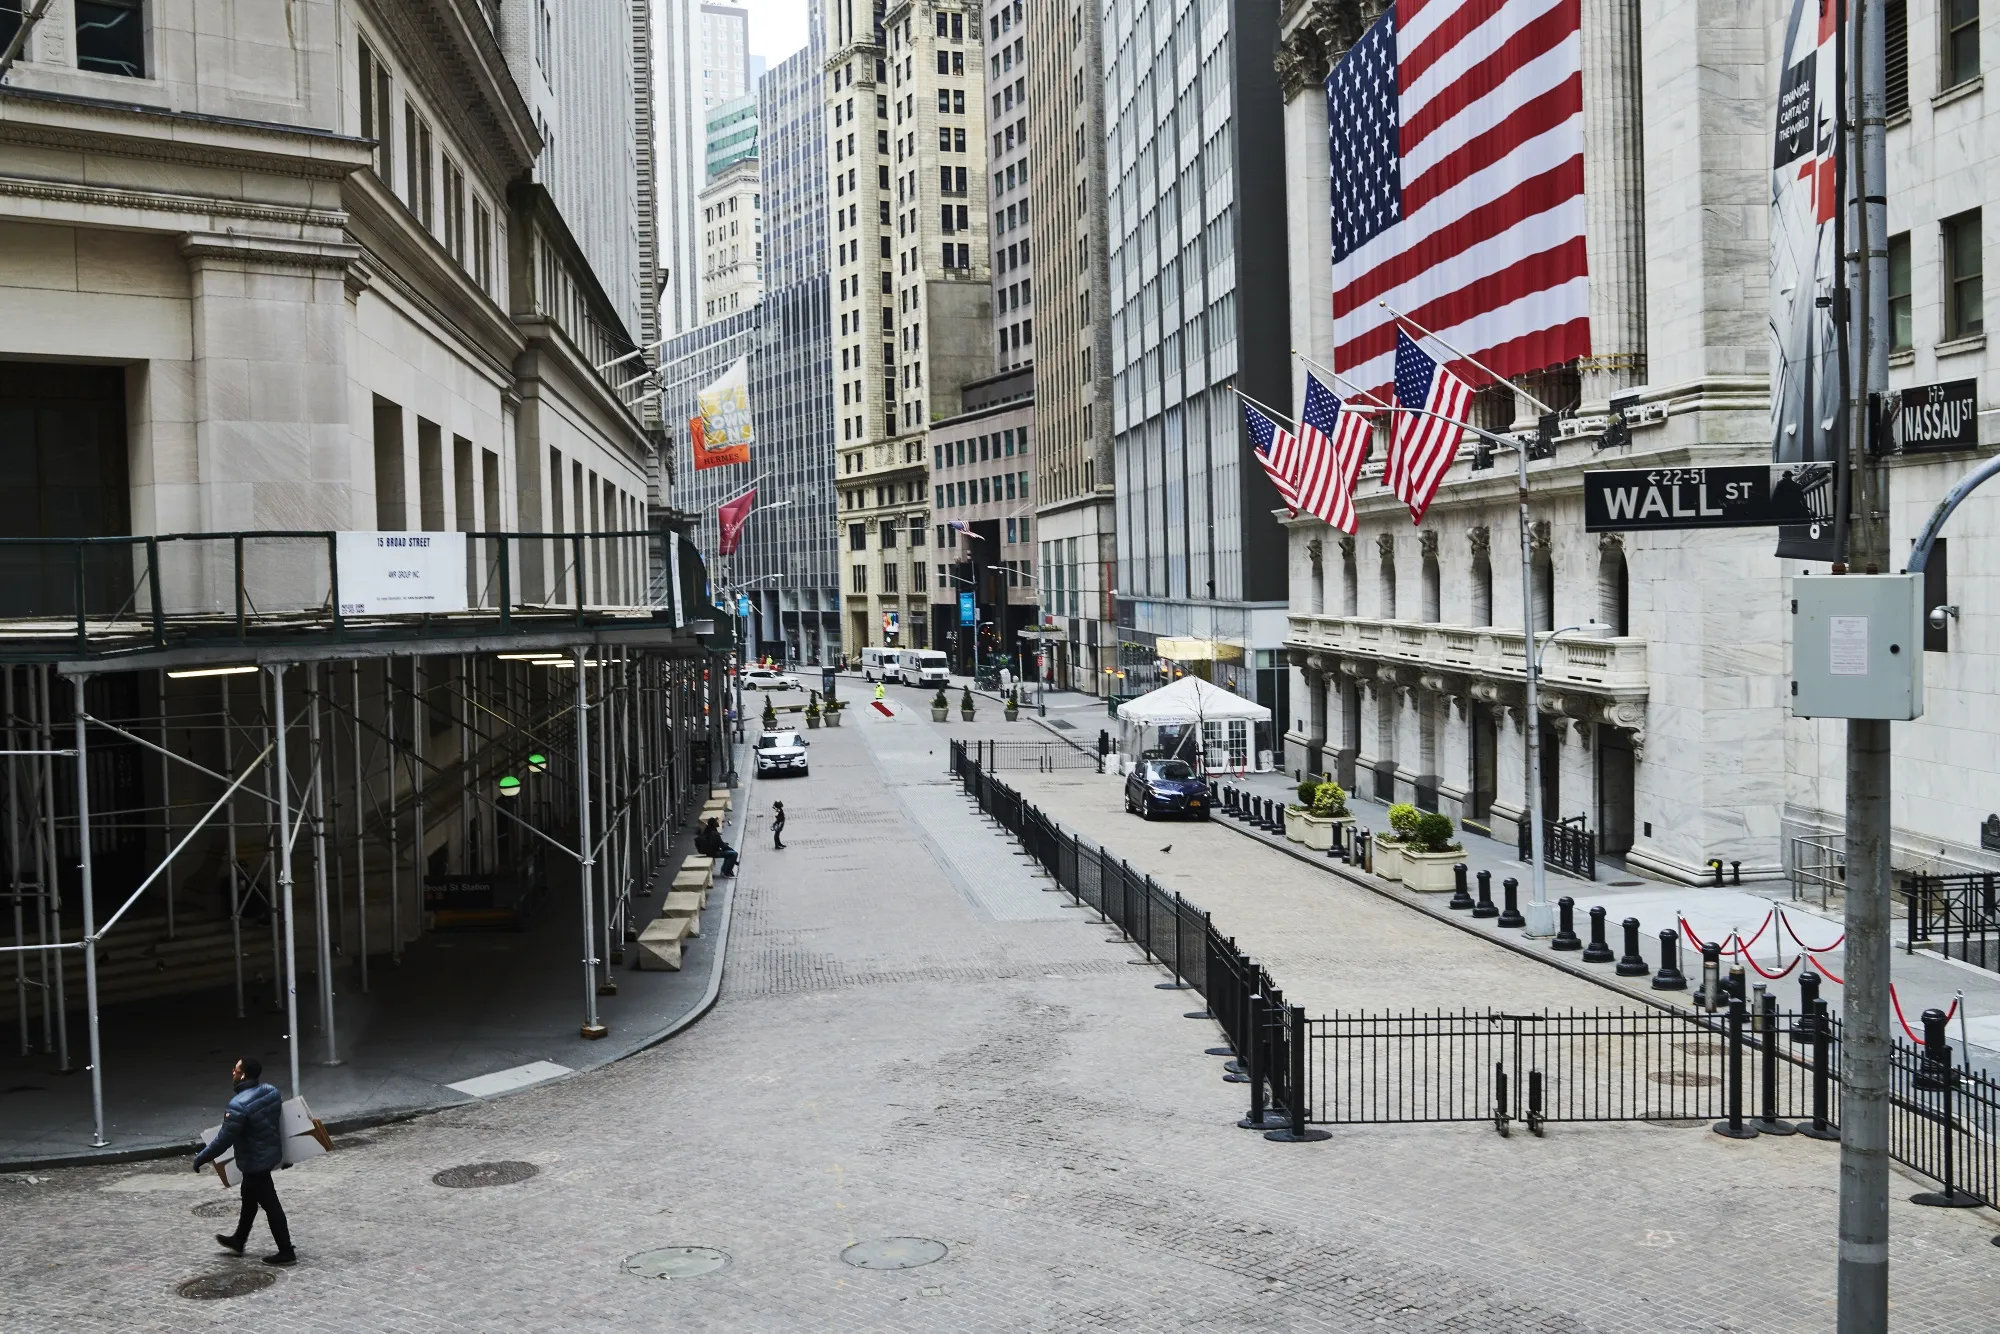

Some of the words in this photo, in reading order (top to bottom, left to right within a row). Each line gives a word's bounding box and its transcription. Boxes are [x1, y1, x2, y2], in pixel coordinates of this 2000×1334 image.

[1782, 80, 1810, 107] FINANCIAL
[1780, 104, 1802, 124] CAPITAL
[1801, 97, 1810, 111] OF
[1779, 128, 1790, 141] THE
[1789, 116, 1809, 135] WORLD
[1928, 385, 1938, 402] 1-7
[1905, 401, 1960, 441] NASSAU
[1962, 398, 1973, 420] ST
[1662, 469, 1706, 485] 22-51
[1603, 484, 1723, 520] WALL
[1725, 482, 1753, 500] ST
[377, 538, 384, 547] 15
[386, 538, 406, 547] BROAD
[408, 538, 430, 547] STREET
[424, 884, 447, 892] Broad
[461, 883, 490, 891] Station
